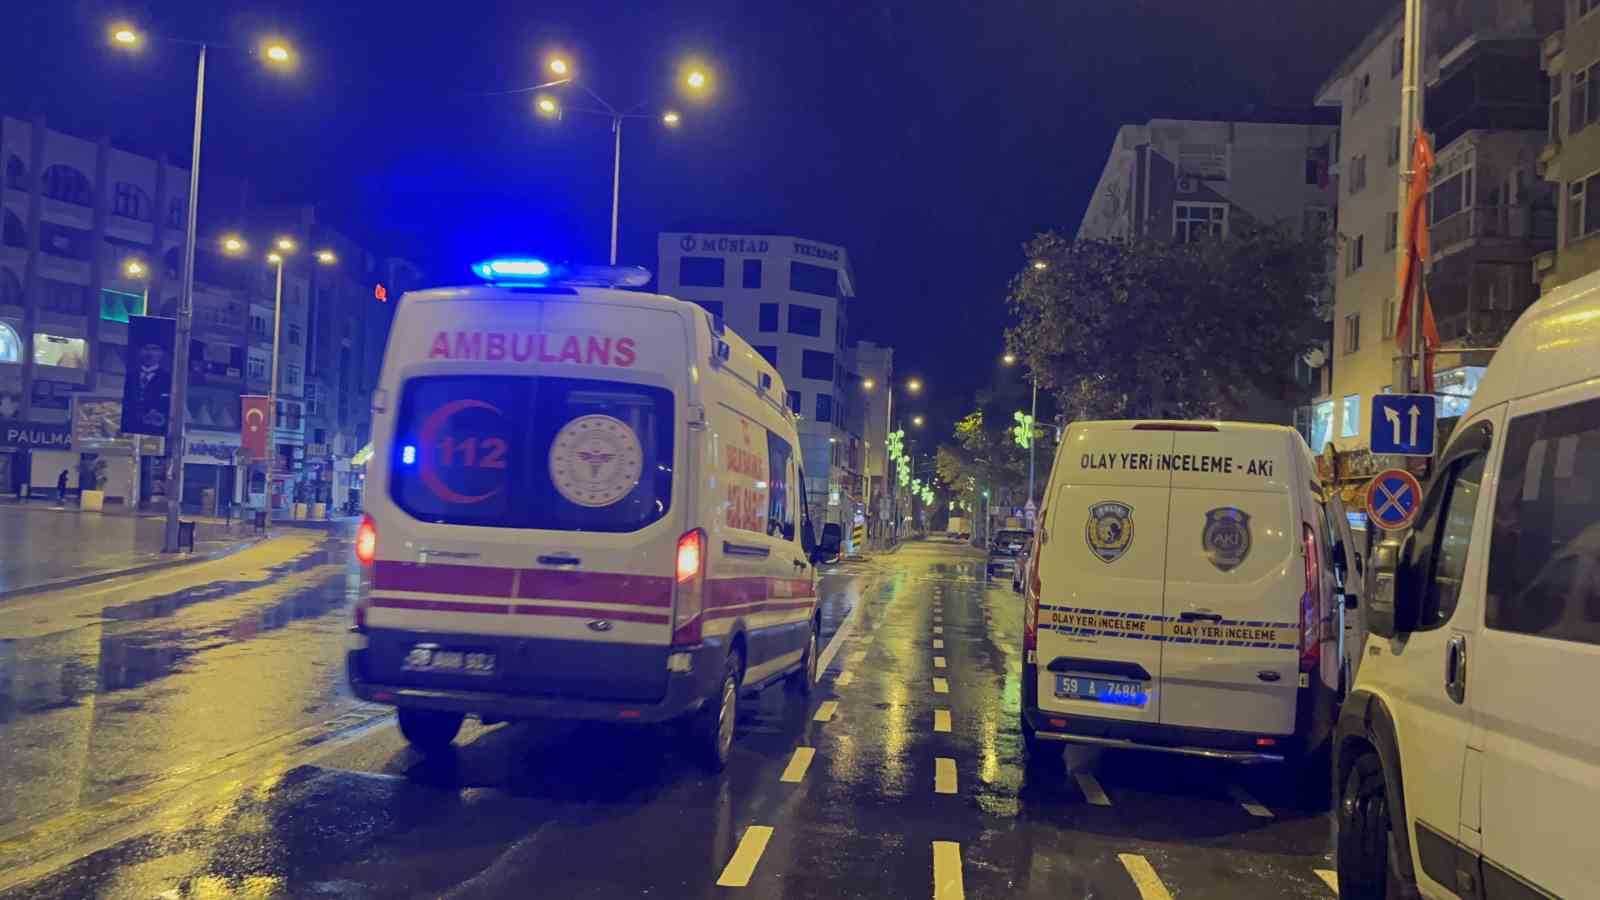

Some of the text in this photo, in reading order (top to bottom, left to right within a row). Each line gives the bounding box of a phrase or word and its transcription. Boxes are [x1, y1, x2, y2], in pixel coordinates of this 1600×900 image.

[702, 235, 769, 253] MÜSİAD
[430, 331, 637, 368] AMBULANS
[438, 436, 507, 469] 112
[1080, 453, 1117, 469] OLAY
[1052, 612, 1075, 625] OLAY
[1173, 624, 1200, 637] OLAY
[1063, 677, 1079, 693] 59
[1088, 680, 1096, 696] A
